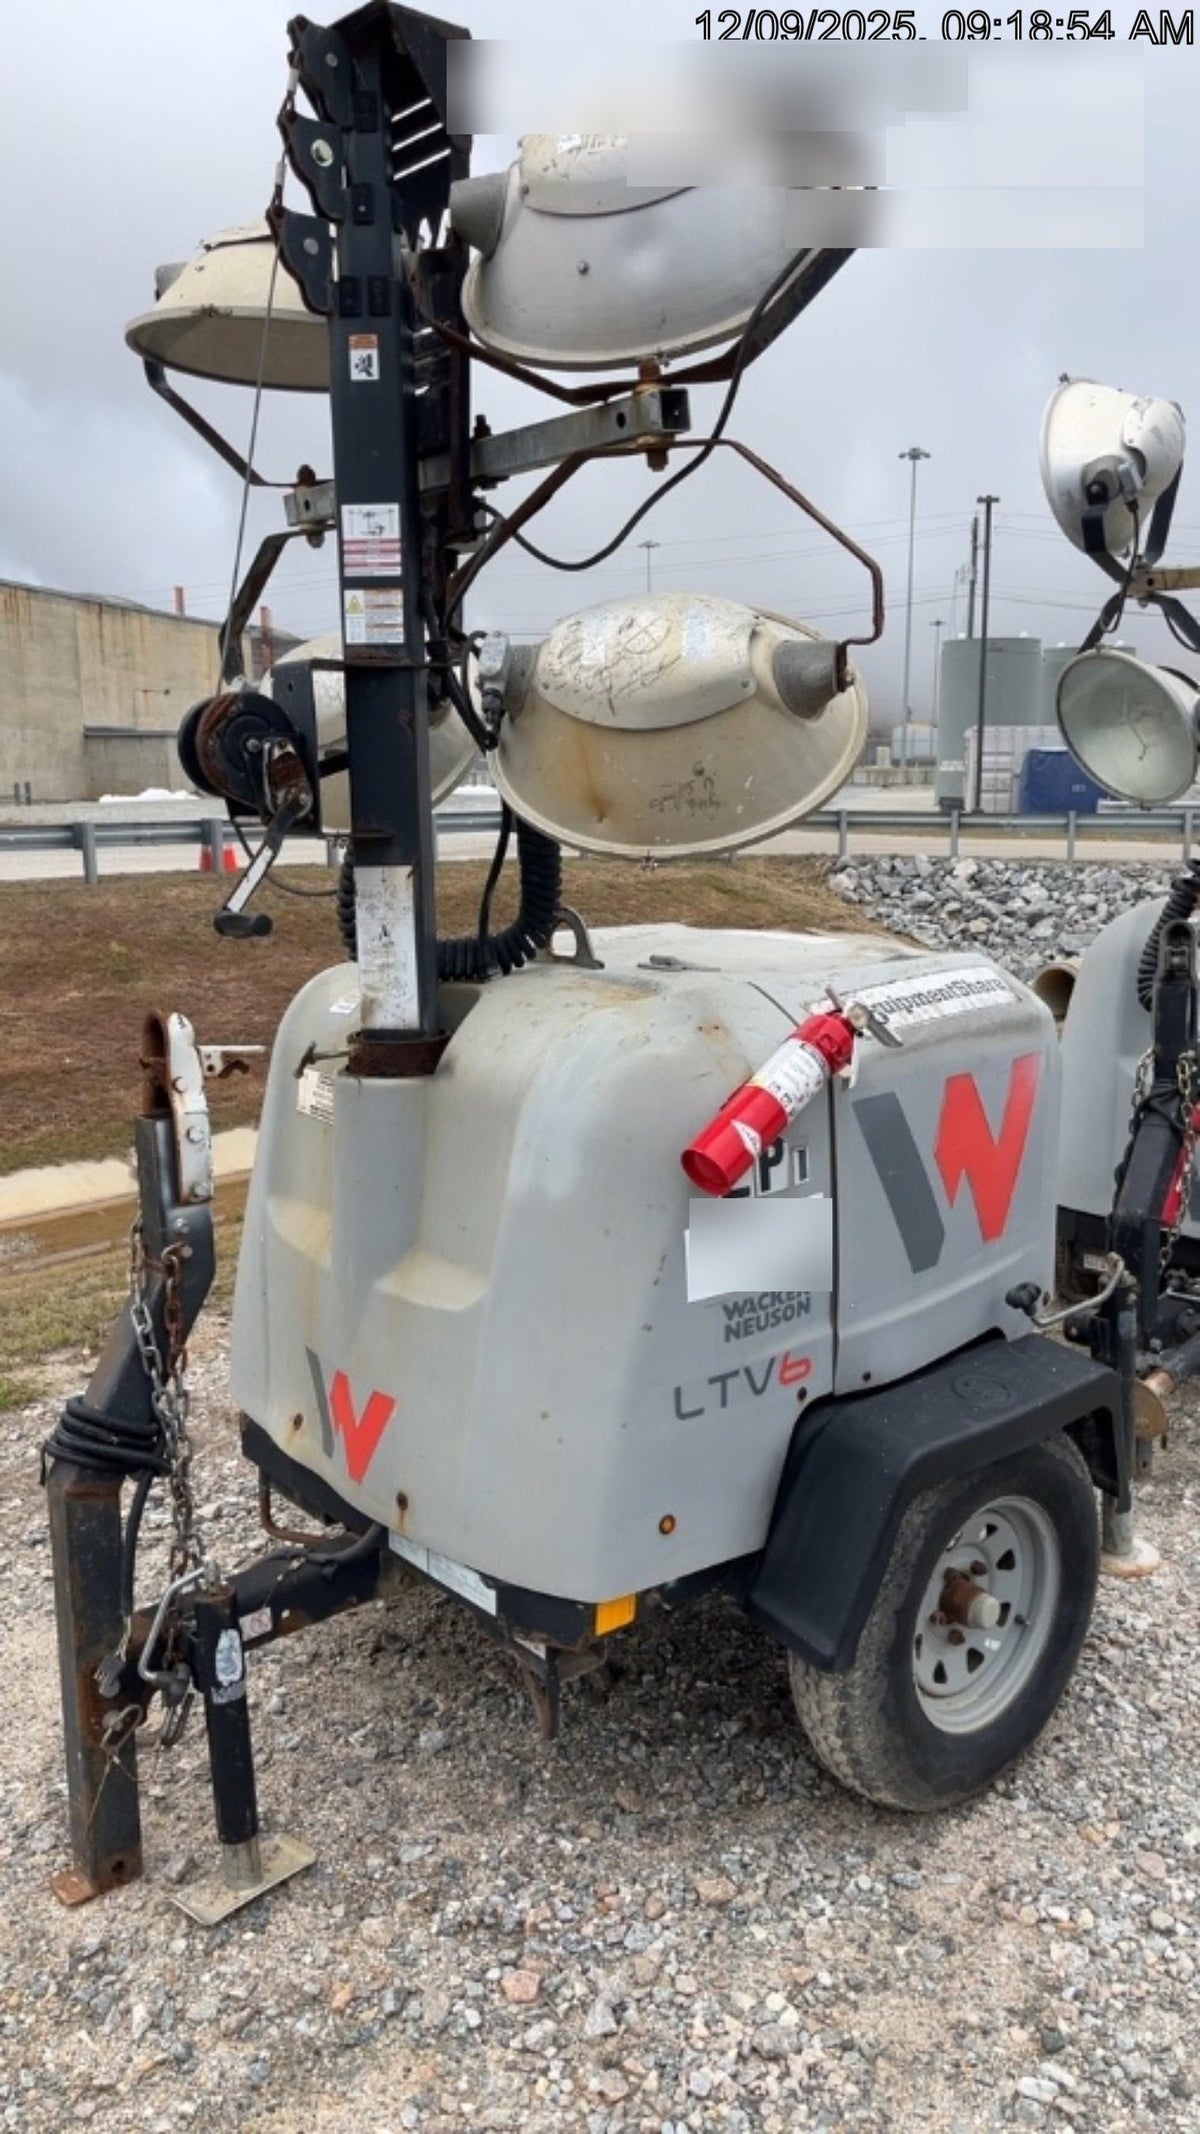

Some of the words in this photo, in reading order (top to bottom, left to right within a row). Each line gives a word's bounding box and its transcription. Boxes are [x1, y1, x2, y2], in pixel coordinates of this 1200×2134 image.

[868, 977, 1008, 1026] quipmentShare
[722, 1290, 812, 1322] WACKE
[724, 1296, 812, 1343] NEUSON
[674, 1351, 813, 1421] LTV6
